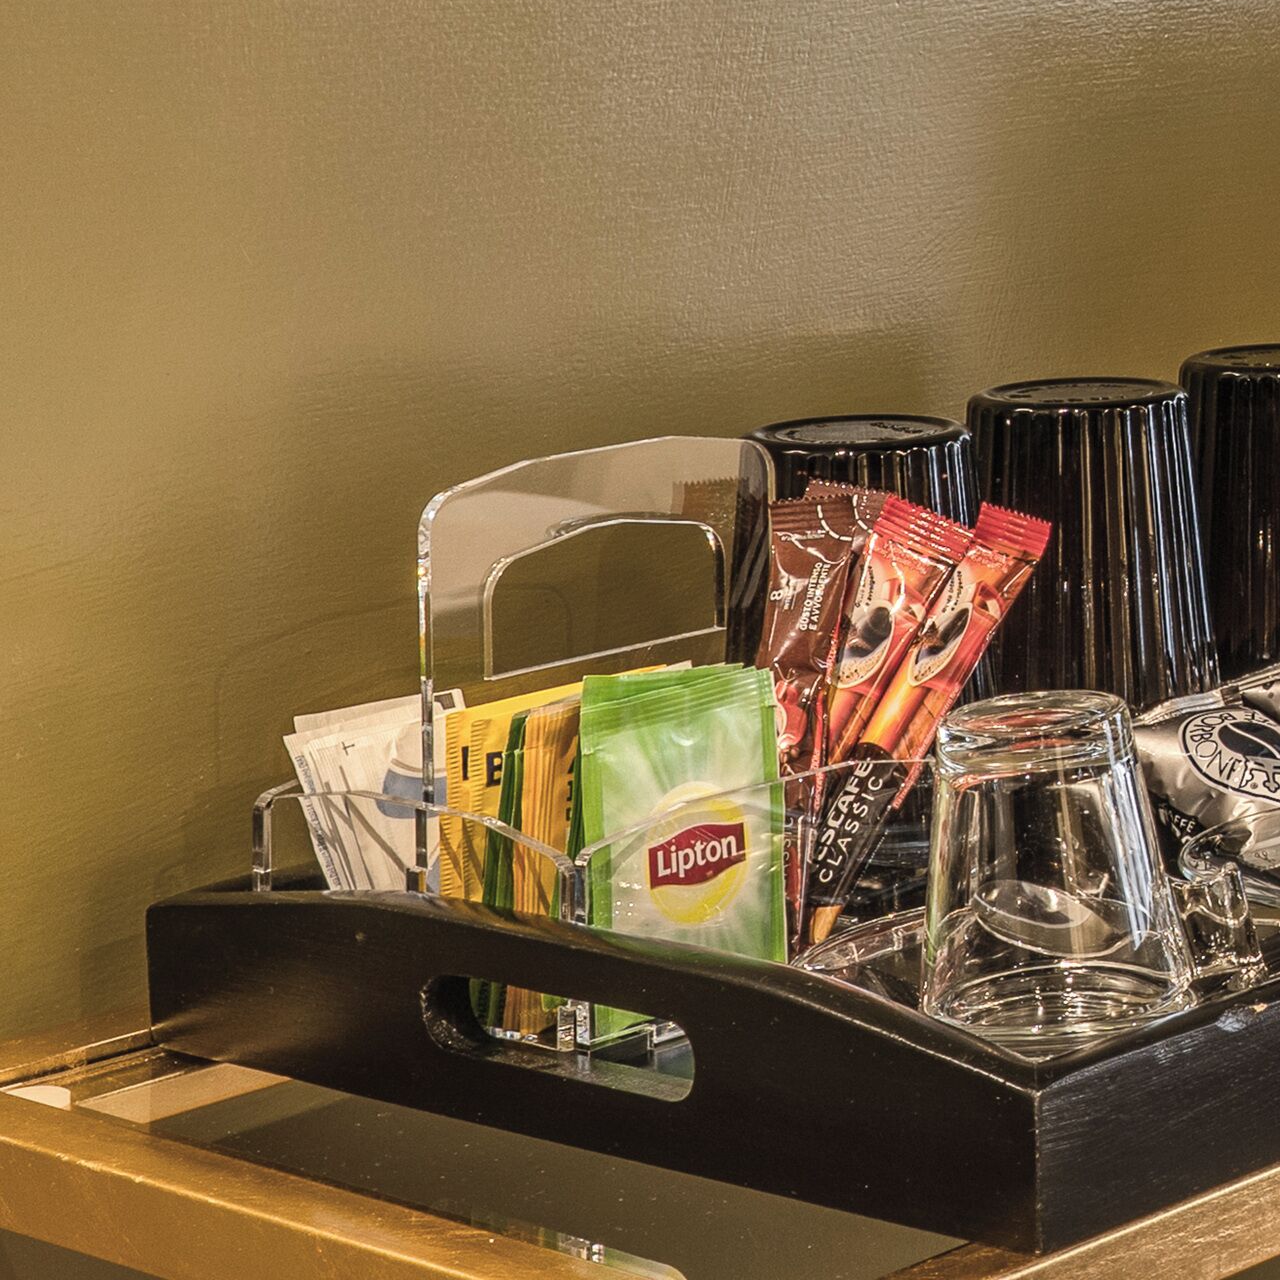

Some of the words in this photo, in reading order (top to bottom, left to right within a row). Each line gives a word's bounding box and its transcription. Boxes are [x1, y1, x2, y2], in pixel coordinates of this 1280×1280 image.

[770, 591, 783, 601] 8
[799, 594, 814, 631] GUSTO
[807, 562, 823, 595] INTENSO
[809, 563, 832, 620] AVVOGENTE
[808, 621, 818, 631] E
[819, 776, 884, 883] CLASSIC
[656, 835, 738, 878] Lipton
